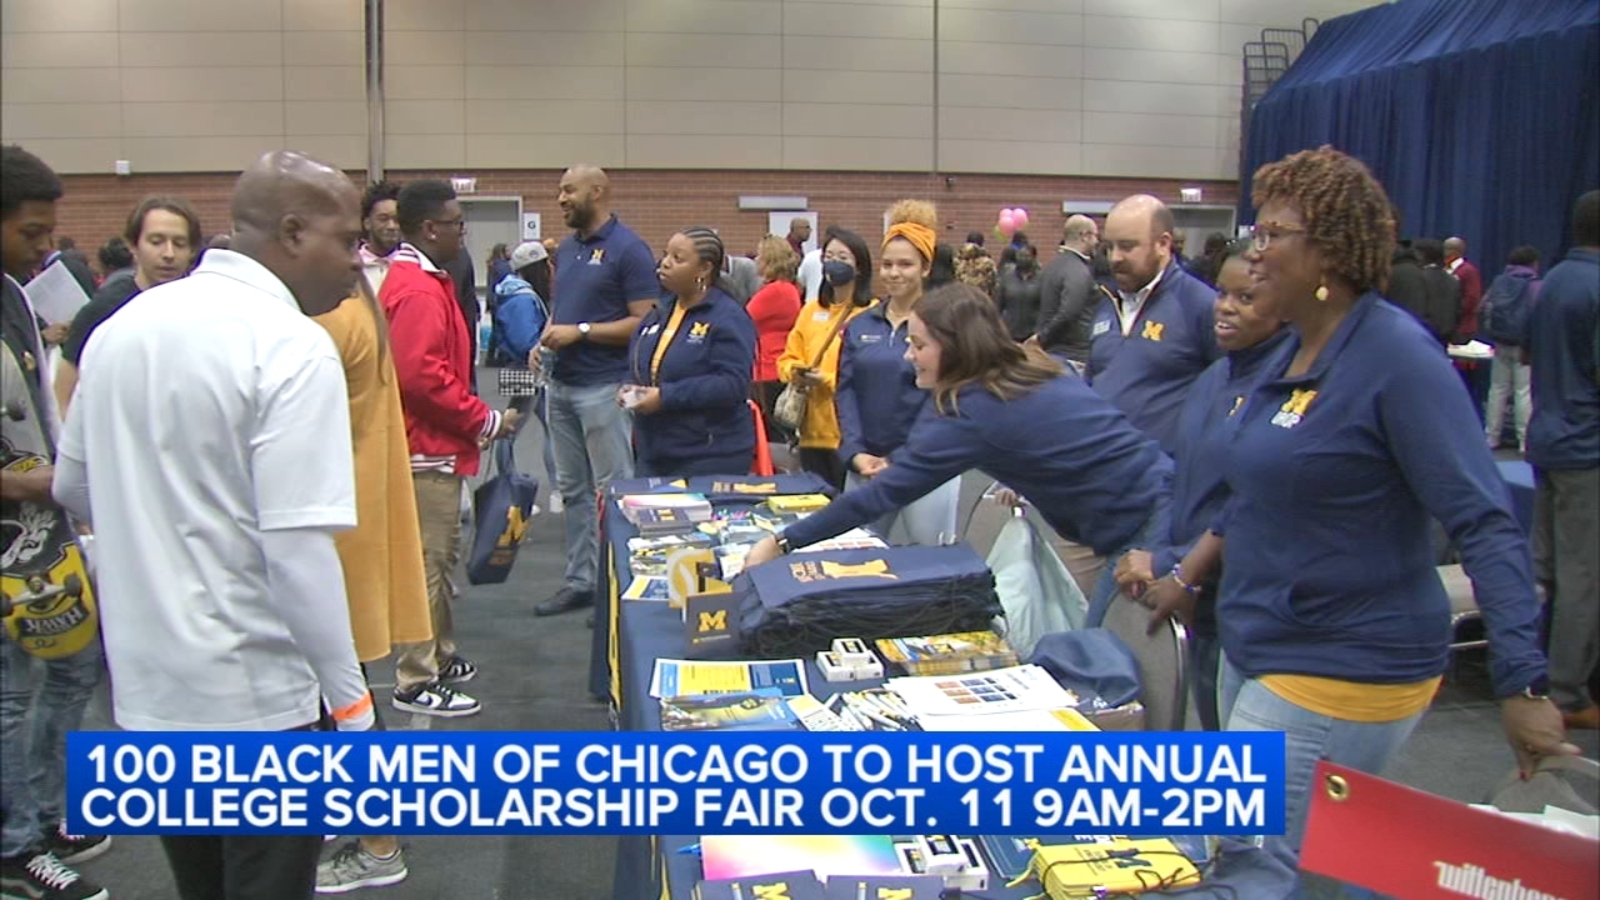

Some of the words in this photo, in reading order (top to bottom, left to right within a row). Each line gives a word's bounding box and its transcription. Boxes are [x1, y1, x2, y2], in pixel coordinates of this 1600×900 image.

[527, 220, 537, 231] G
[1142, 320, 1165, 341] M
[699, 609, 727, 633] M
